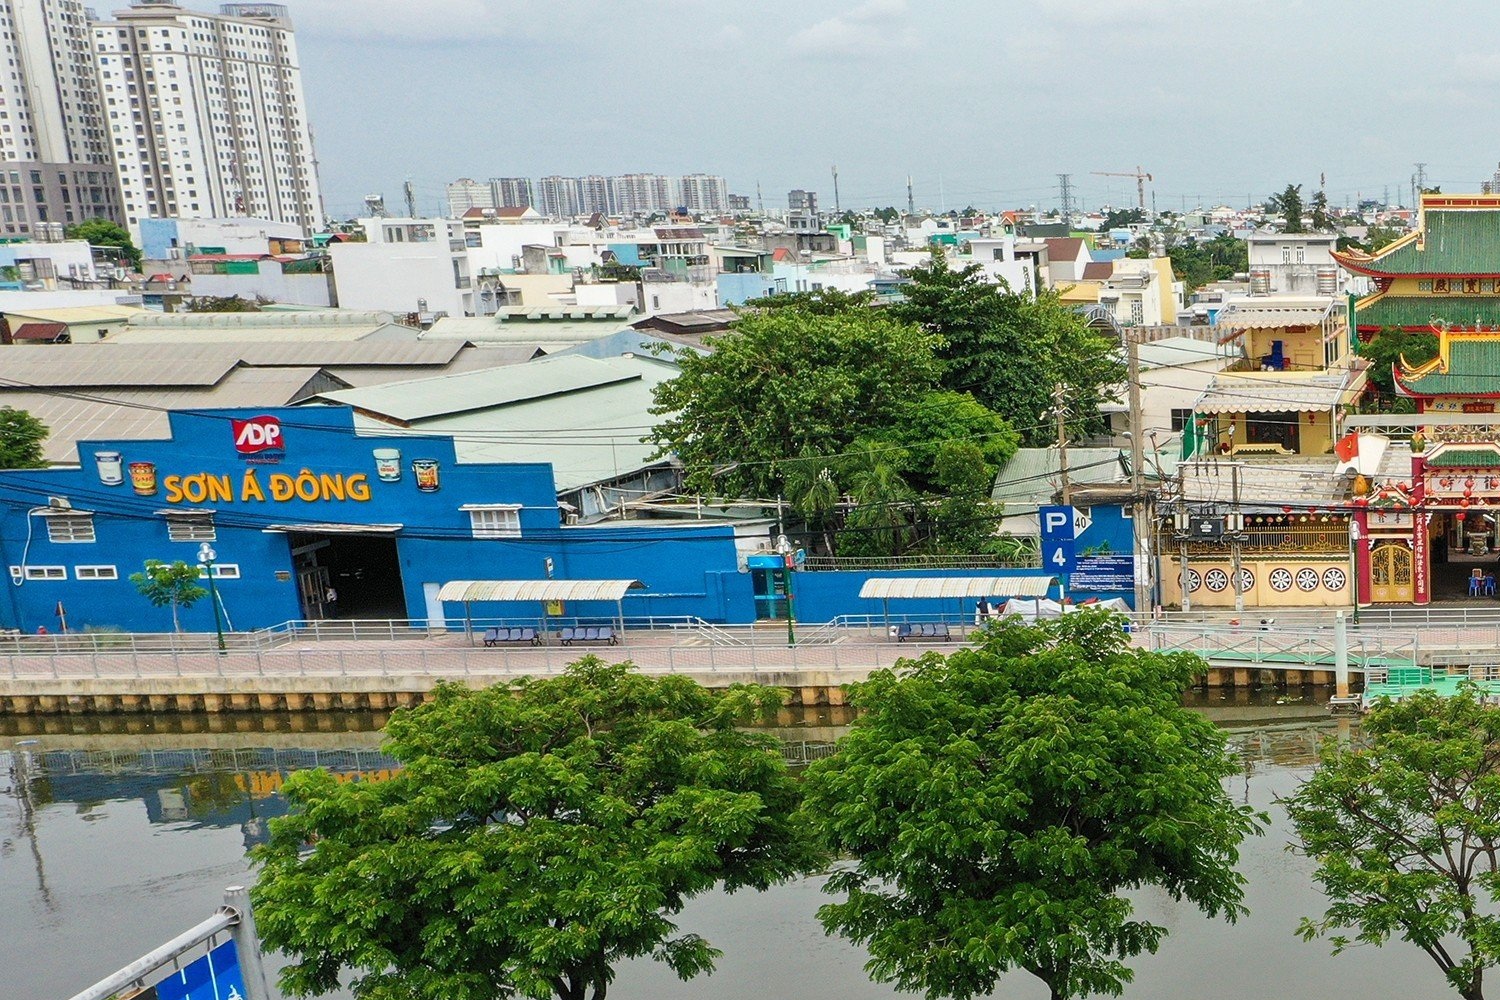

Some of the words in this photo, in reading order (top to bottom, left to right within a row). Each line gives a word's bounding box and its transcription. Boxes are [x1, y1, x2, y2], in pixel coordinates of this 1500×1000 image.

[236, 423, 280, 445] ADP
[165, 472, 231, 503] SƠN
[241, 469, 266, 501] Á
[269, 468, 371, 501] ĐÔNG
[1046, 512, 1067, 533] P
[1075, 517, 1087, 529] 40
[1052, 547, 1066, 566] 4
